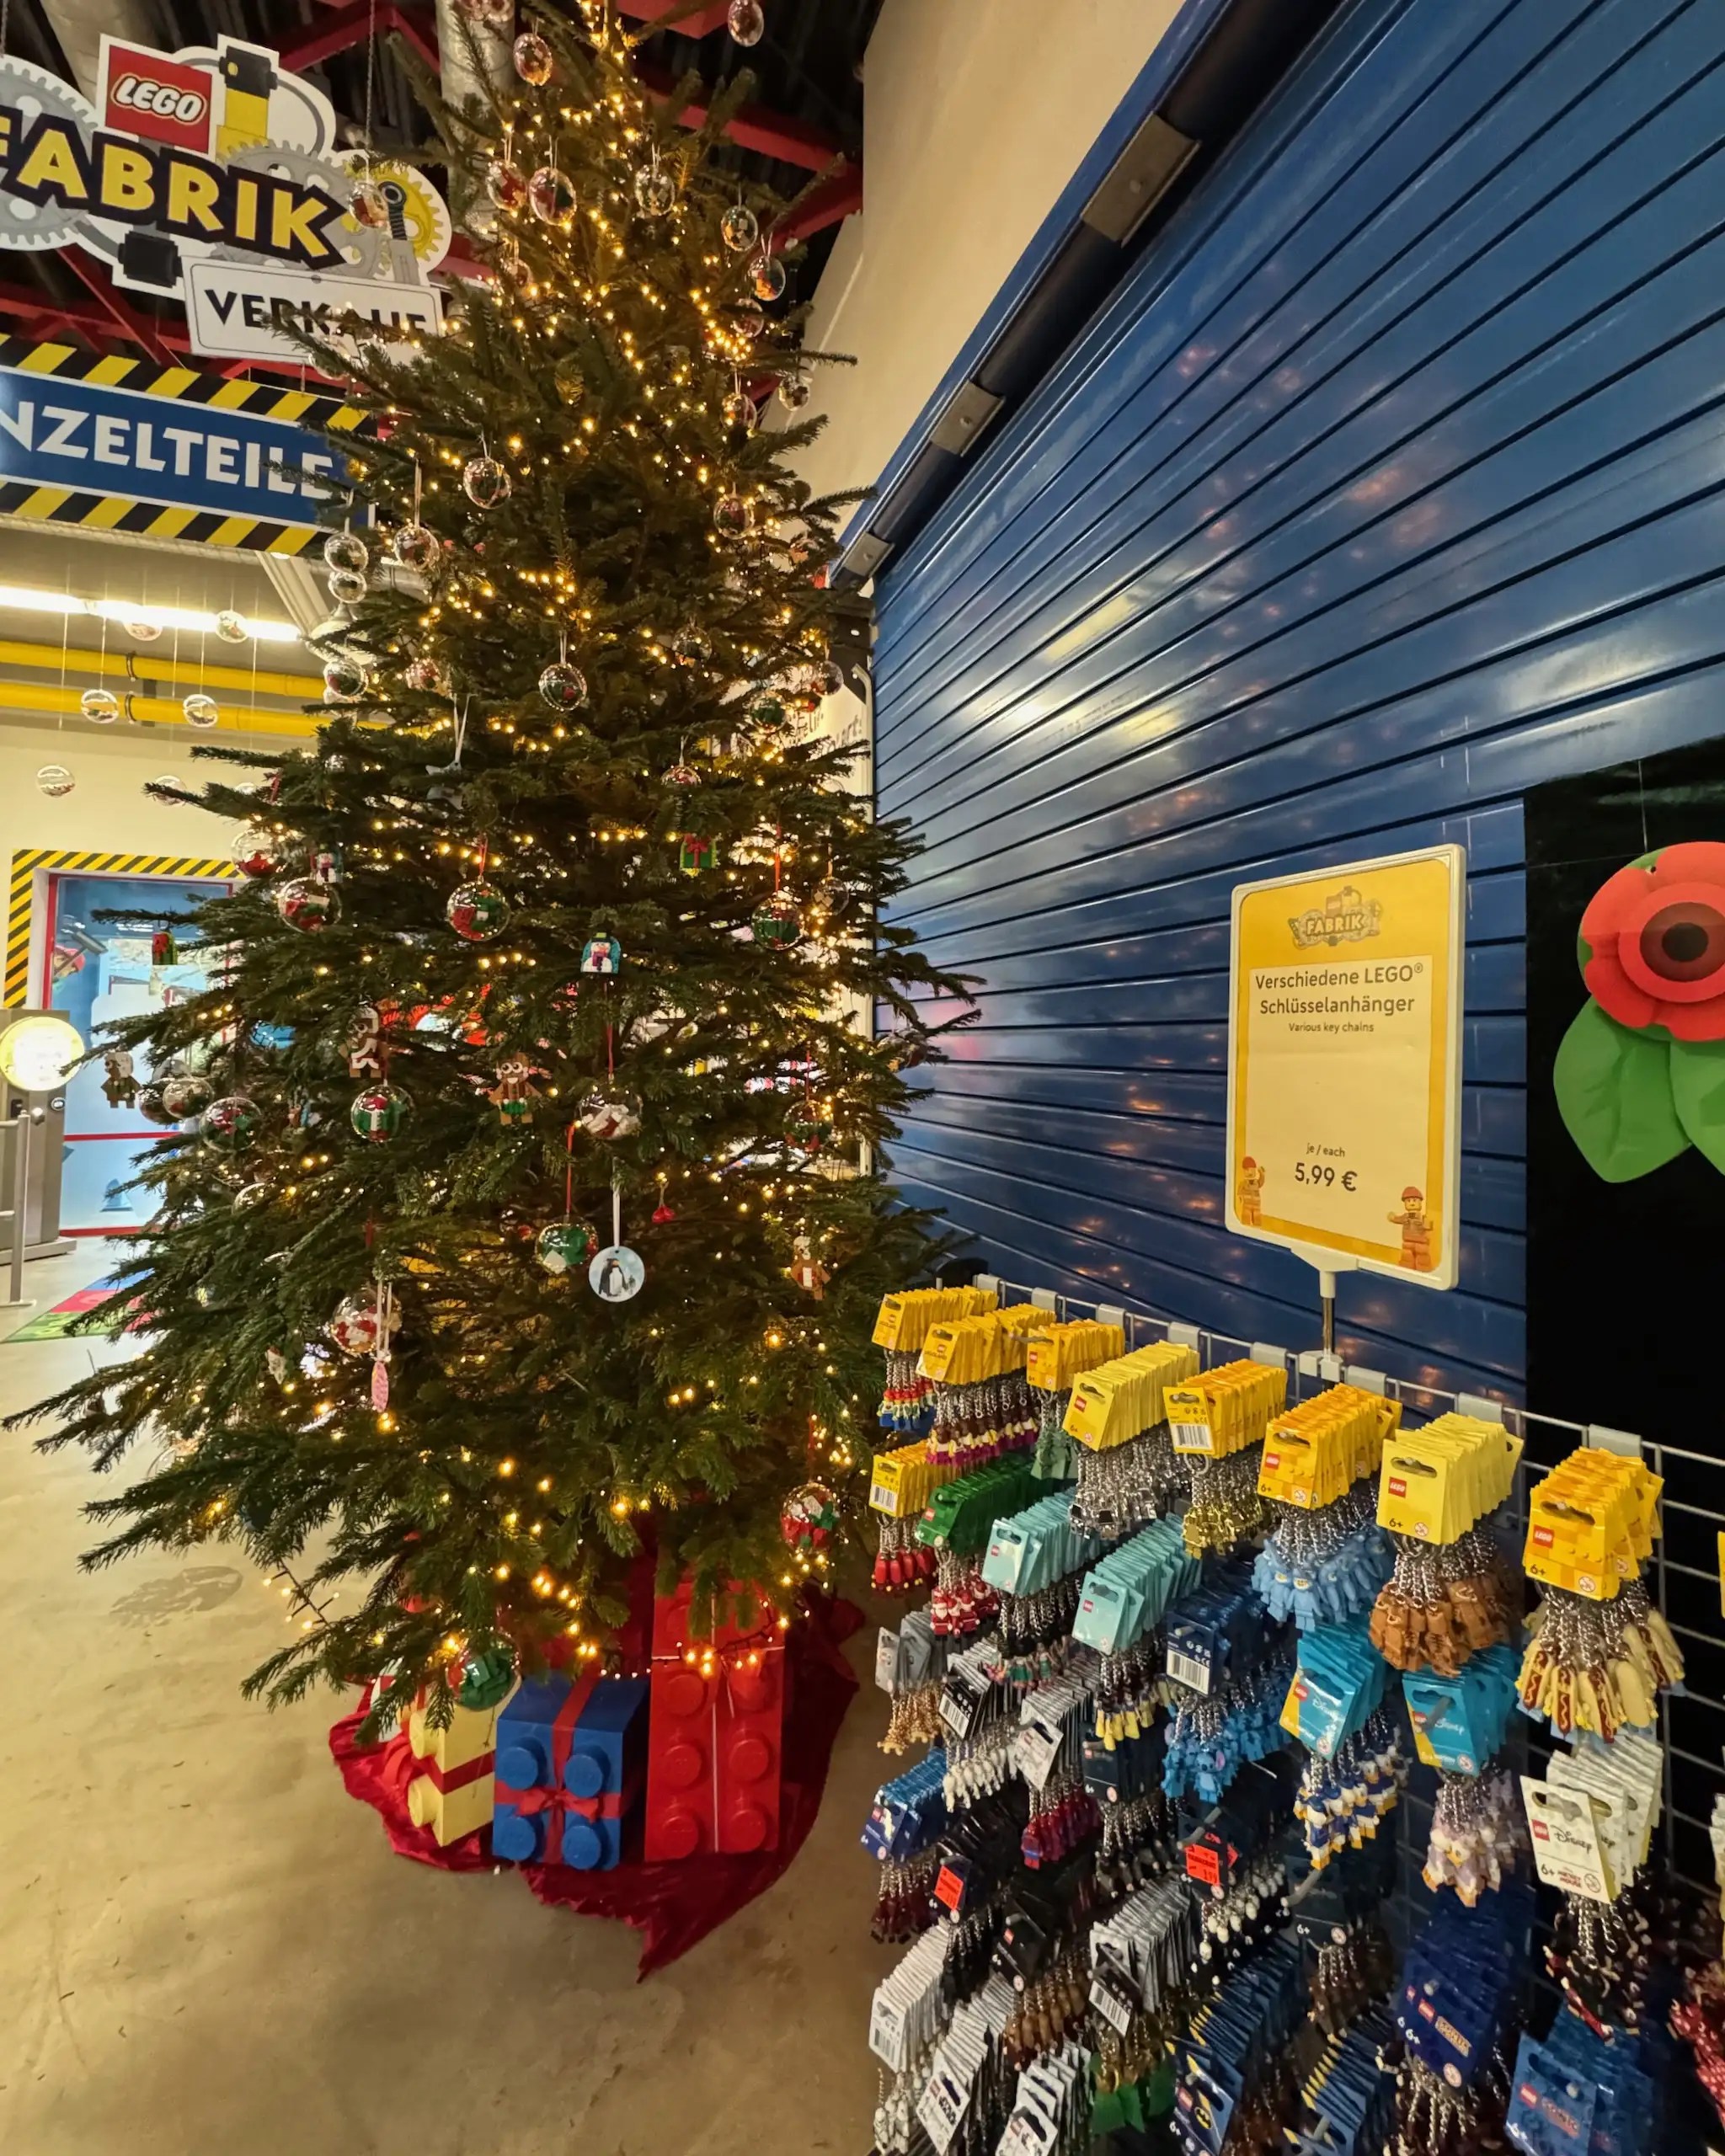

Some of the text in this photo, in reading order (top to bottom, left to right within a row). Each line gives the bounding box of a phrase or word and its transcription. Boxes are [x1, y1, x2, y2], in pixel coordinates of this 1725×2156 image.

[115, 75, 205, 123] LEGO
[1306, 914, 1365, 937] FABRIK
[1255, 969, 1359, 990] Verschiedene
[1260, 995, 1415, 1017] Schlüsselanhänger
[1289, 1022, 1375, 1034] Various key chains
[1306, 1143, 1315, 1155] je
[1322, 1146, 1346, 1158] each
[1294, 1162, 1358, 1192] 5,99 €
[1389, 1481, 1406, 1492] LEGO
[1389, 1518, 1403, 1528] 6+
[1530, 1564, 1546, 1575] 6+
[1550, 1823, 1593, 1854] Disney
[1541, 1863, 1555, 1876] 6+
[1297, 1924, 1310, 1935] 6+
